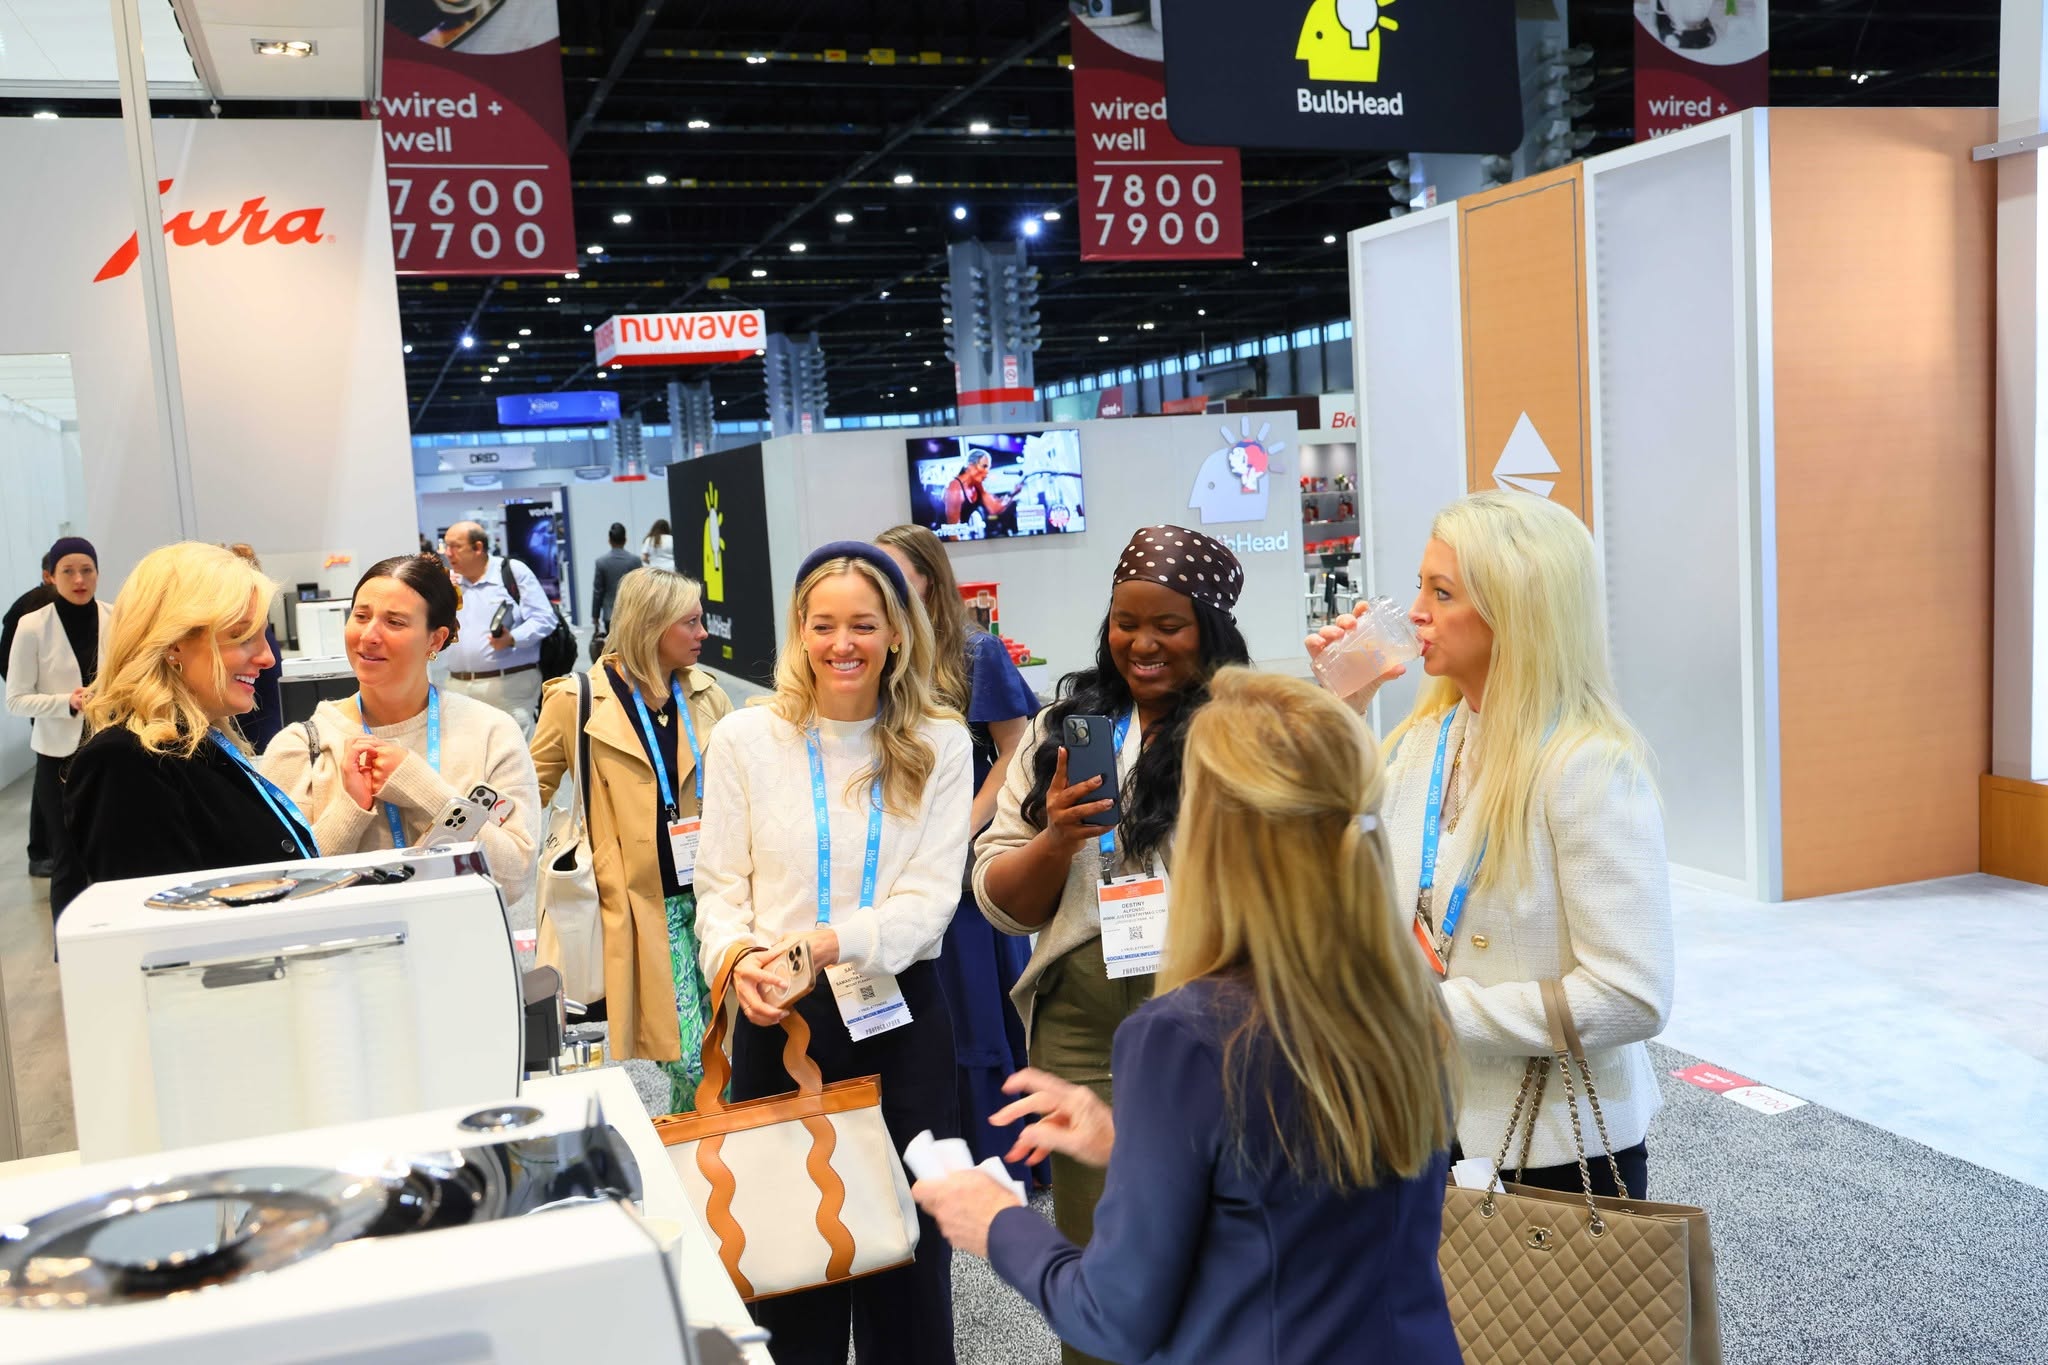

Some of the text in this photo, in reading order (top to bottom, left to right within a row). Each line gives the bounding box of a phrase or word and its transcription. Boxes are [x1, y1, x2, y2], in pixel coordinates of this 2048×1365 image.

[382, 91, 478, 118] wired
[1091, 97, 1168, 120] wired
[1297, 88, 1404, 116] BulbHead
[1648, 95, 1712, 117] wired
[385, 126, 452, 152] well
[1092, 128, 1146, 150] well
[388, 179, 543, 216] 7600
[1093, 173, 1217, 207] 7800
[392, 222, 545, 259] 7700
[1095, 212, 1220, 246] 7900
[620, 313, 758, 343] nuwave
[1122, 901, 1145, 909] DESTINY
